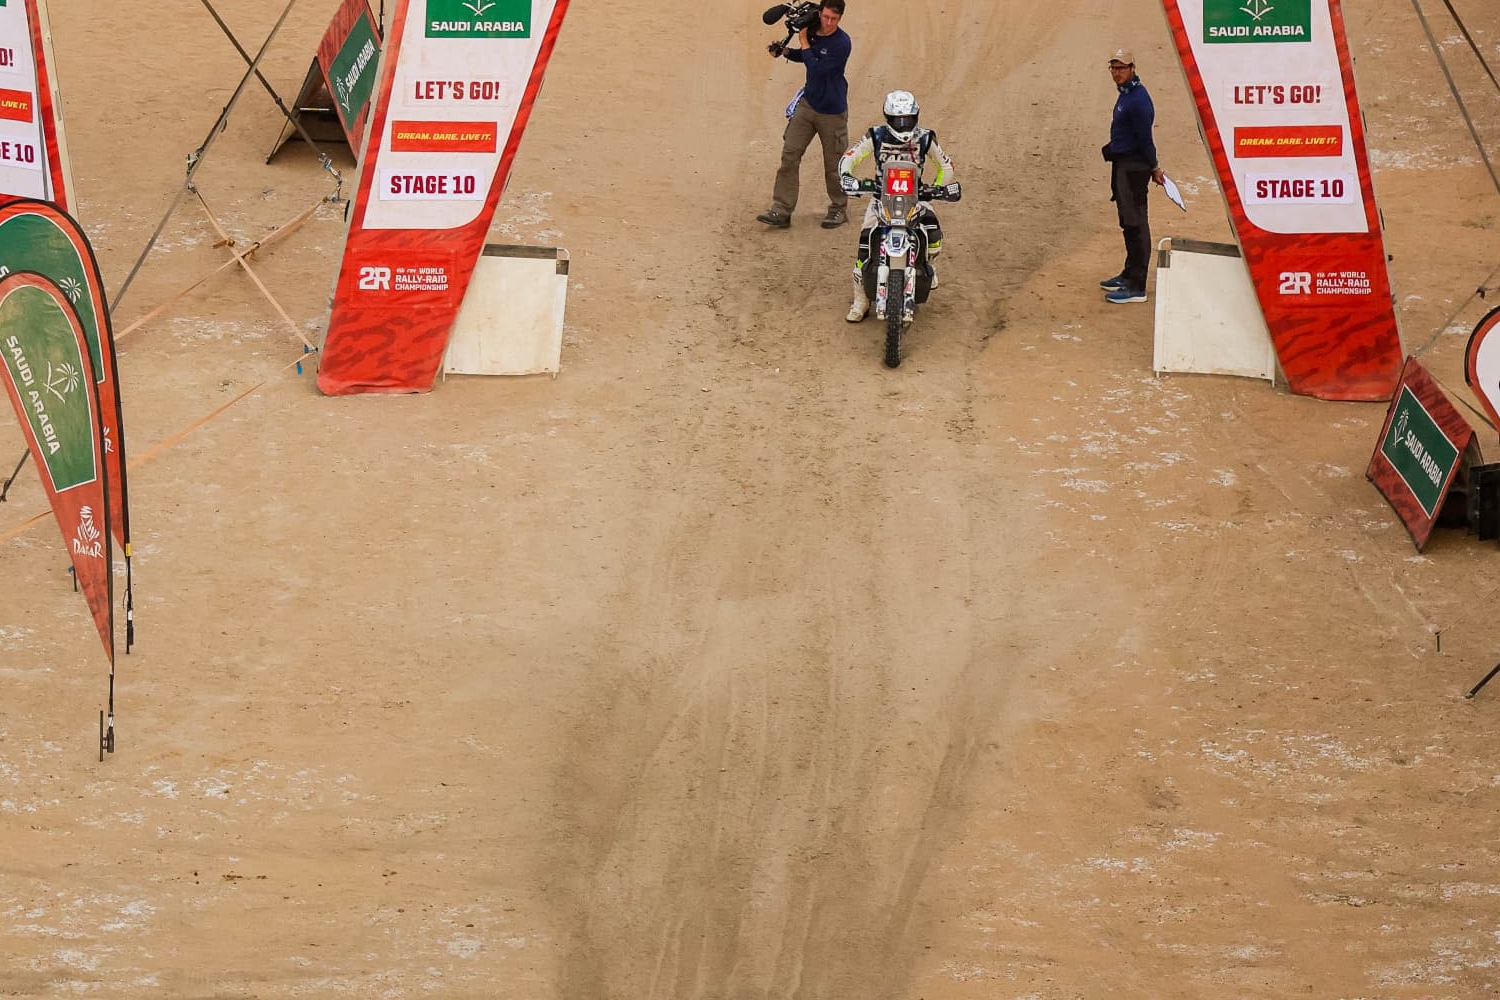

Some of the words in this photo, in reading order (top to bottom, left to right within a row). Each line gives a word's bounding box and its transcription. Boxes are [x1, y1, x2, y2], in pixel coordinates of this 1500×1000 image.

[431, 21, 471, 32] SAUDI
[473, 21, 525, 32] ARABIA
[1209, 26, 1250, 37] SAUDI
[1252, 25, 1305, 37] ARABIA
[345, 62, 360, 93] SAUDI
[356, 38, 376, 74] ARABIA
[469, 80, 499, 100] GO!
[1289, 85, 1321, 104] GO!
[1, 99, 18, 109] LIVE
[18, 101, 29, 111] IT.
[397, 132, 431, 140] DREAM.
[433, 132, 458, 140] DARE.
[460, 132, 481, 140] LIVE
[481, 132, 492, 140] IT.
[1239, 138, 1275, 146] DREAM.
[1276, 138, 1303, 146] DARE.
[1305, 137, 1326, 145] LIVE
[1326, 137, 1338, 145] IT.
[15, 143, 35, 163] 10
[390, 175, 448, 195] STAGE
[452, 175, 476, 195] 10
[891, 180, 909, 192] 44
[1256, 180, 1316, 198] STAGE
[1320, 179, 1344, 198] 10
[395, 275, 447, 284] RALLY-RAID
[1316, 279, 1370, 287] RALLY-RAID
[1316, 287, 1372, 295] CHAMPIONSHIP
[6, 335, 35, 387] SAUDI
[29, 391, 61, 456] ARABIA
[1404, 429, 1424, 459] SAUDI
[1419, 451, 1443, 489] ARABIA
[72, 539, 103, 558] DAKAR
